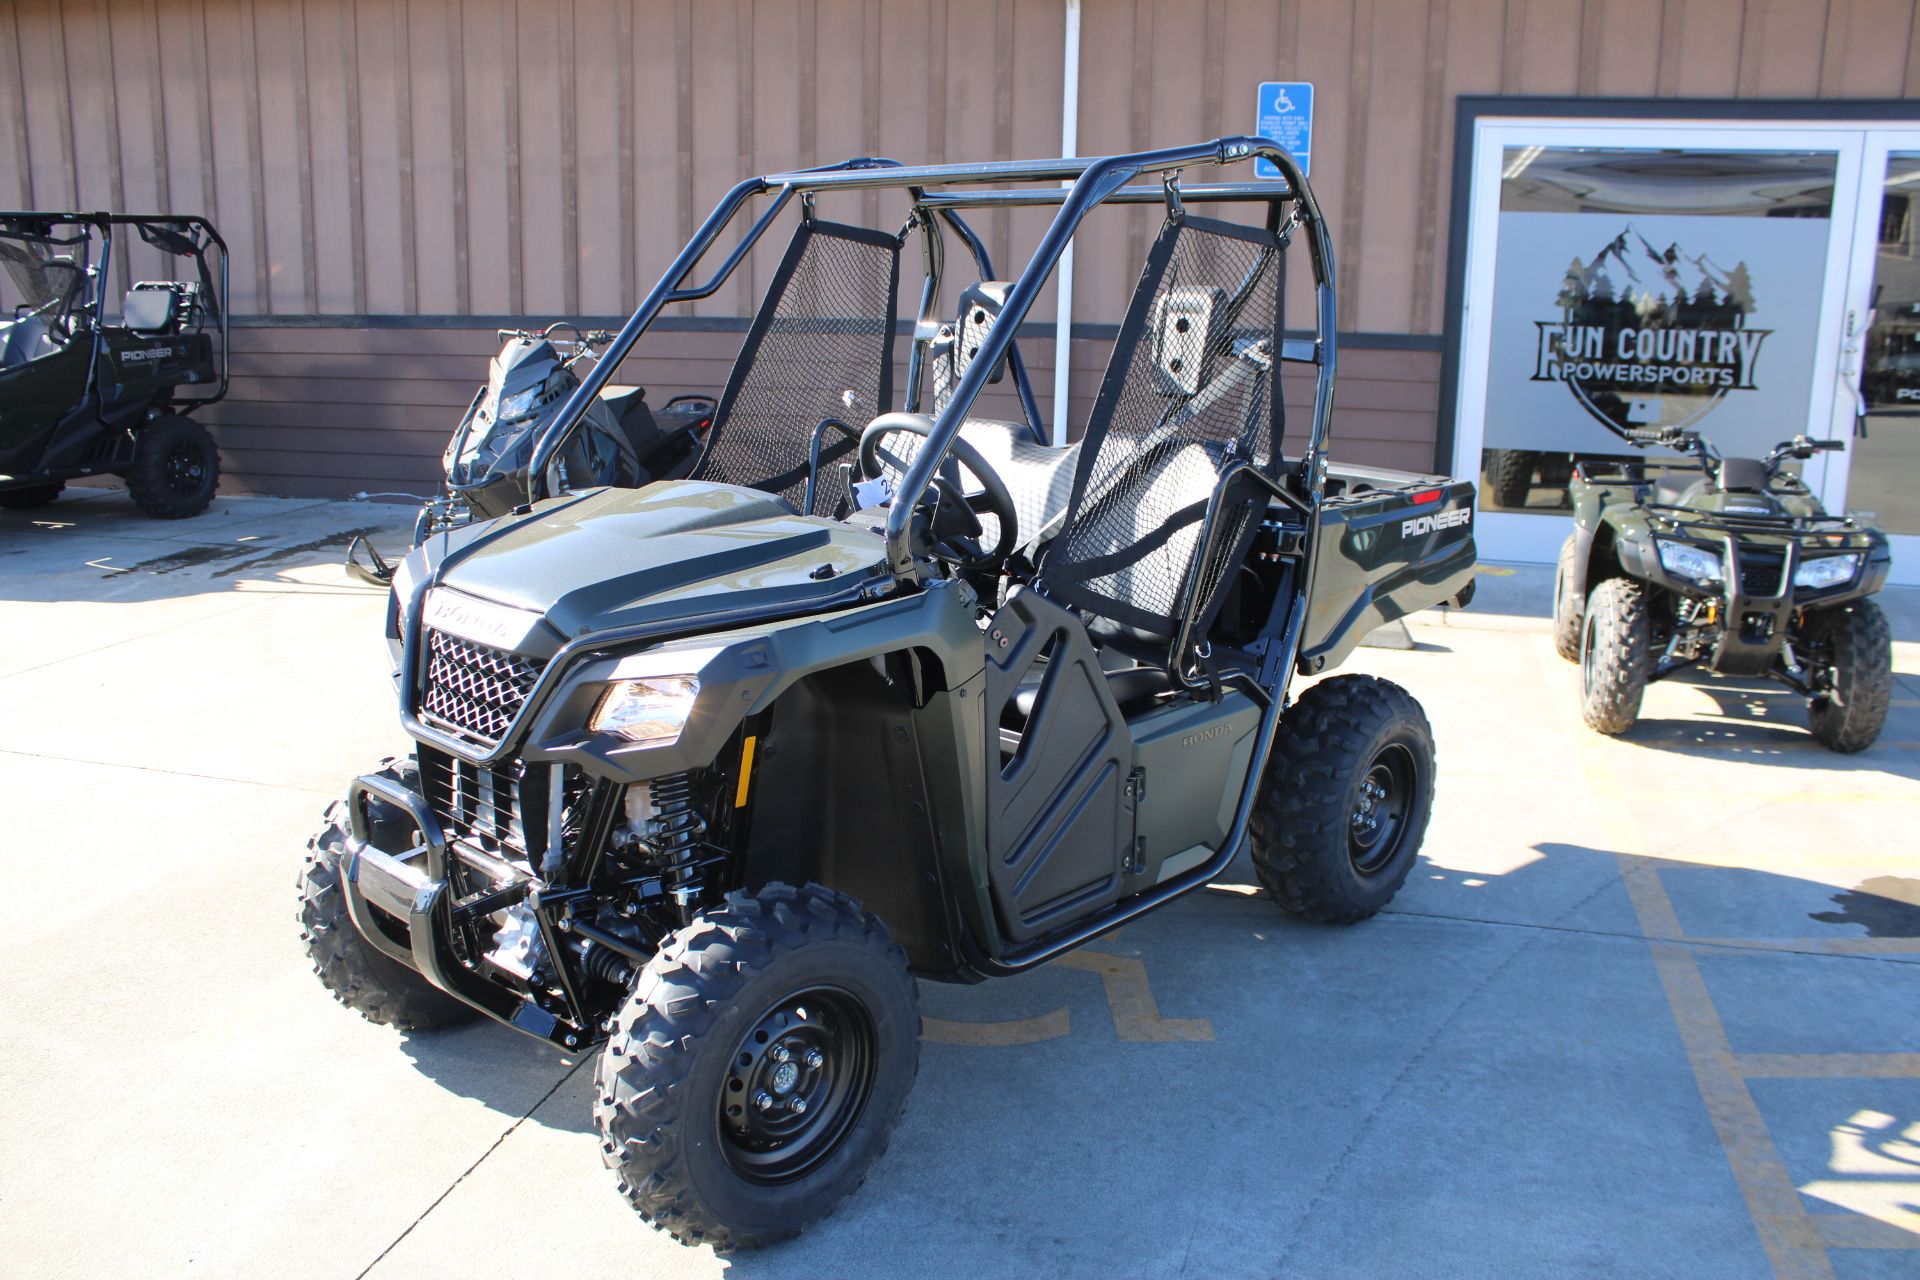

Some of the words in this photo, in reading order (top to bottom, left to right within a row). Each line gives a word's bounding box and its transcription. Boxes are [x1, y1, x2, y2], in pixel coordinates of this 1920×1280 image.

[121, 347, 172, 361] PIONEER
[1531, 321, 1604, 380] FUN
[1618, 327, 1773, 389] COUNTRY
[1563, 361, 1734, 385] POWERSPORTS
[1401, 507, 1471, 539] PIONEER
[1182, 723, 1233, 748] HONDA
